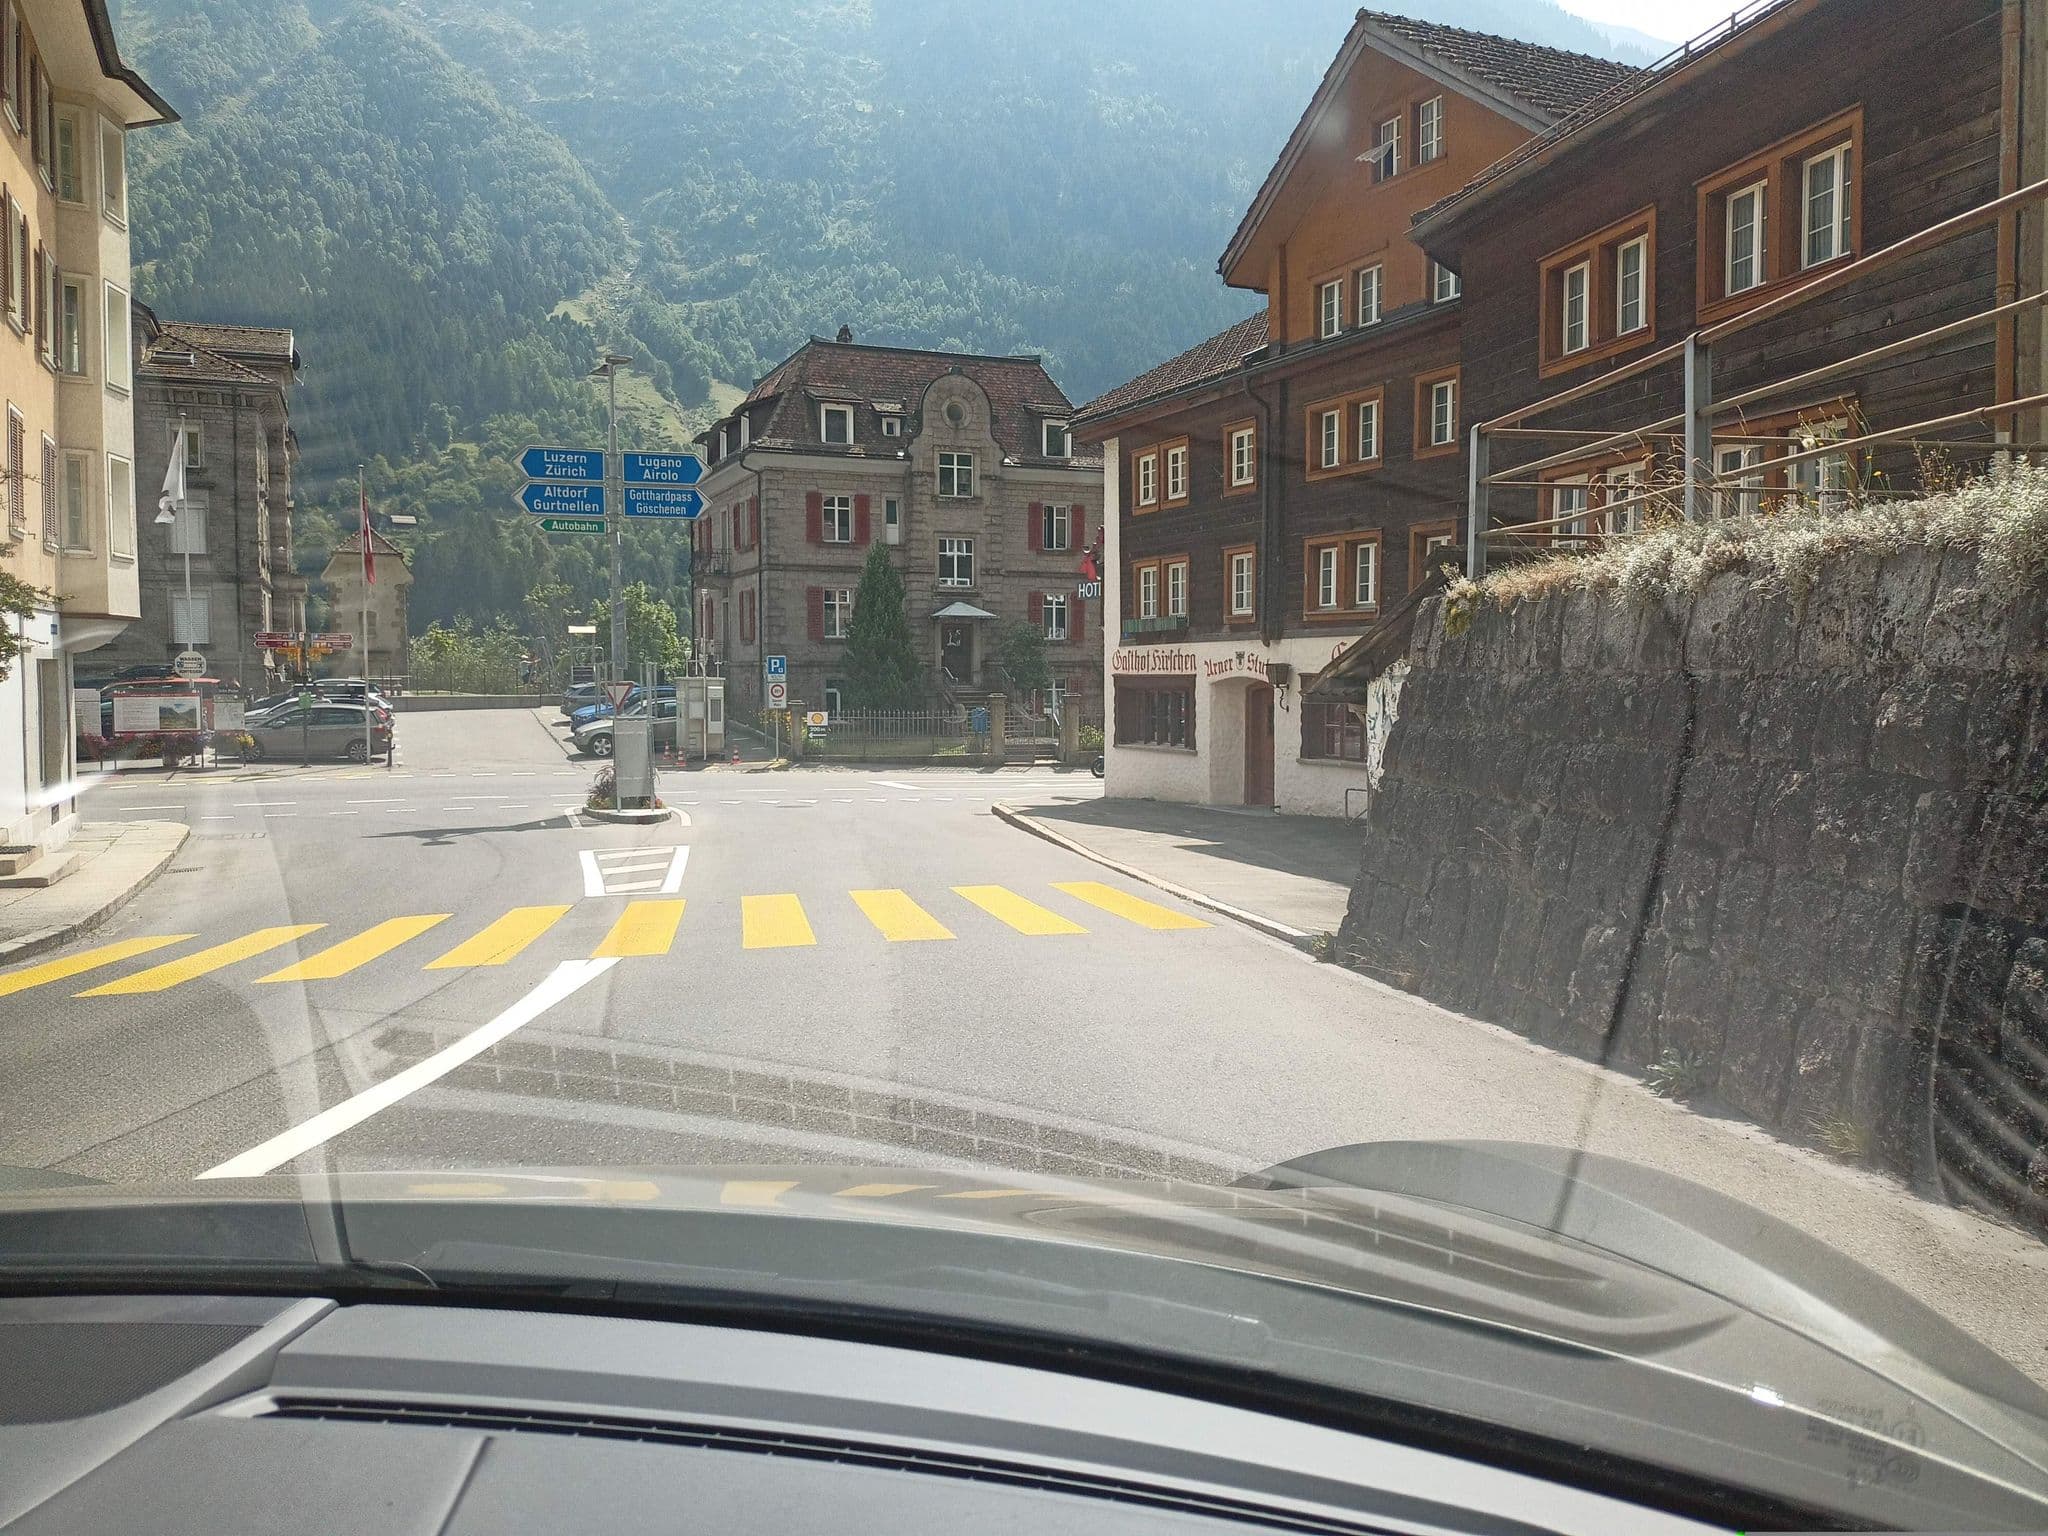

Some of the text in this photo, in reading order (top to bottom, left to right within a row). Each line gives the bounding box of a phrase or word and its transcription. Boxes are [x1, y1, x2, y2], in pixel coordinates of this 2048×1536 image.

[543, 450, 588, 464] Luzern
[638, 455, 683, 469] Lugano
[545, 463, 587, 477] Zürich
[643, 469, 680, 481] Airolo
[544, 486, 588, 498] Altdorf
[629, 489, 693, 503] Gotthardpass
[533, 499, 600, 512] Gurtnellen
[636, 502, 687, 515] Göschenen
[551, 520, 599, 531] Autobahn
[771, 659, 780, 672] P
[1247, 652, 1269, 675] Stu
